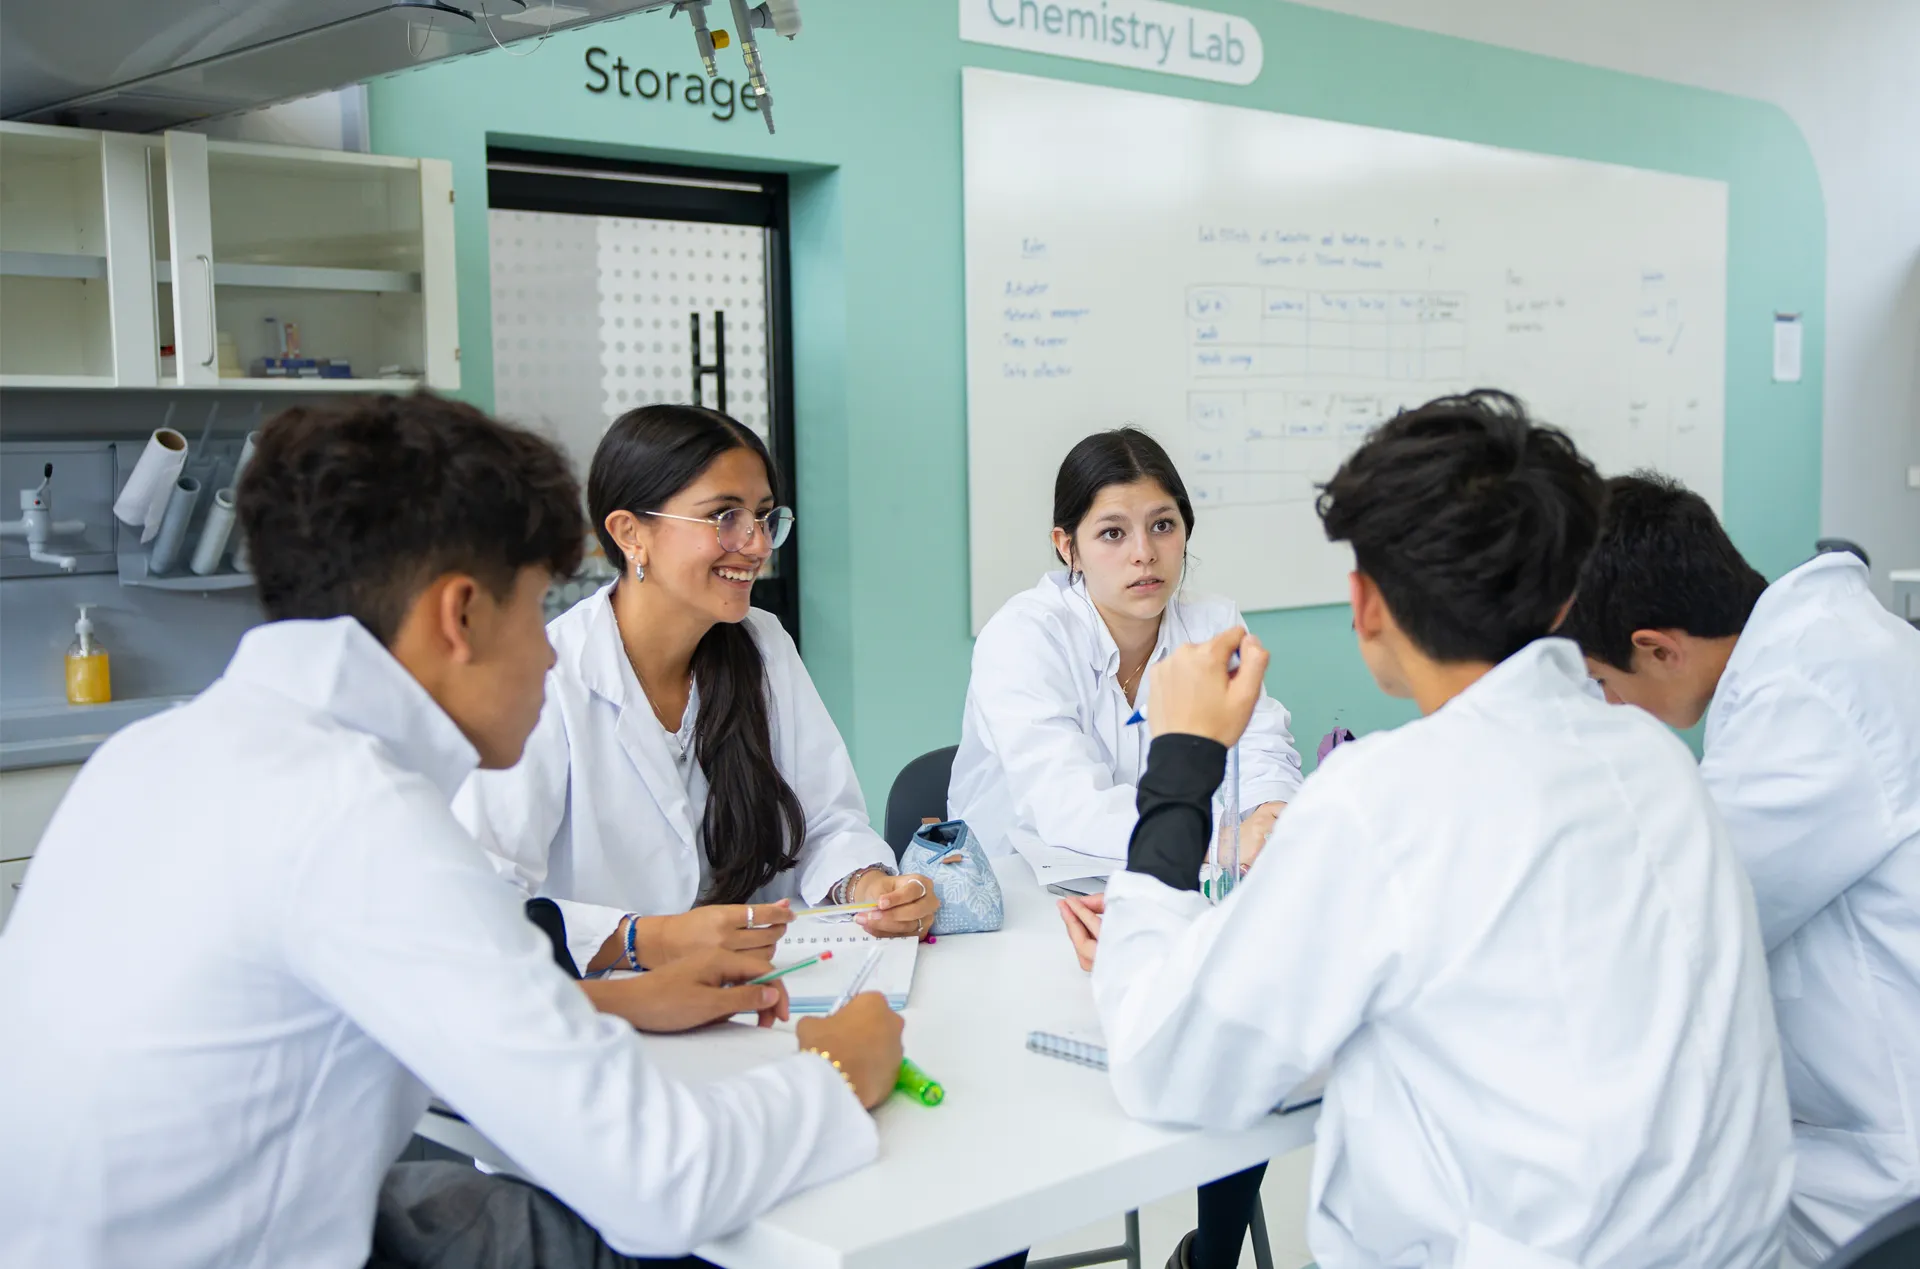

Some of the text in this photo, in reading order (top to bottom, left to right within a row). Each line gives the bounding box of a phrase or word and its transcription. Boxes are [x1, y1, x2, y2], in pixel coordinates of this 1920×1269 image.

[988, 0, 1246, 66] Chemistry Lab
[584, 46, 760, 121] Storage
